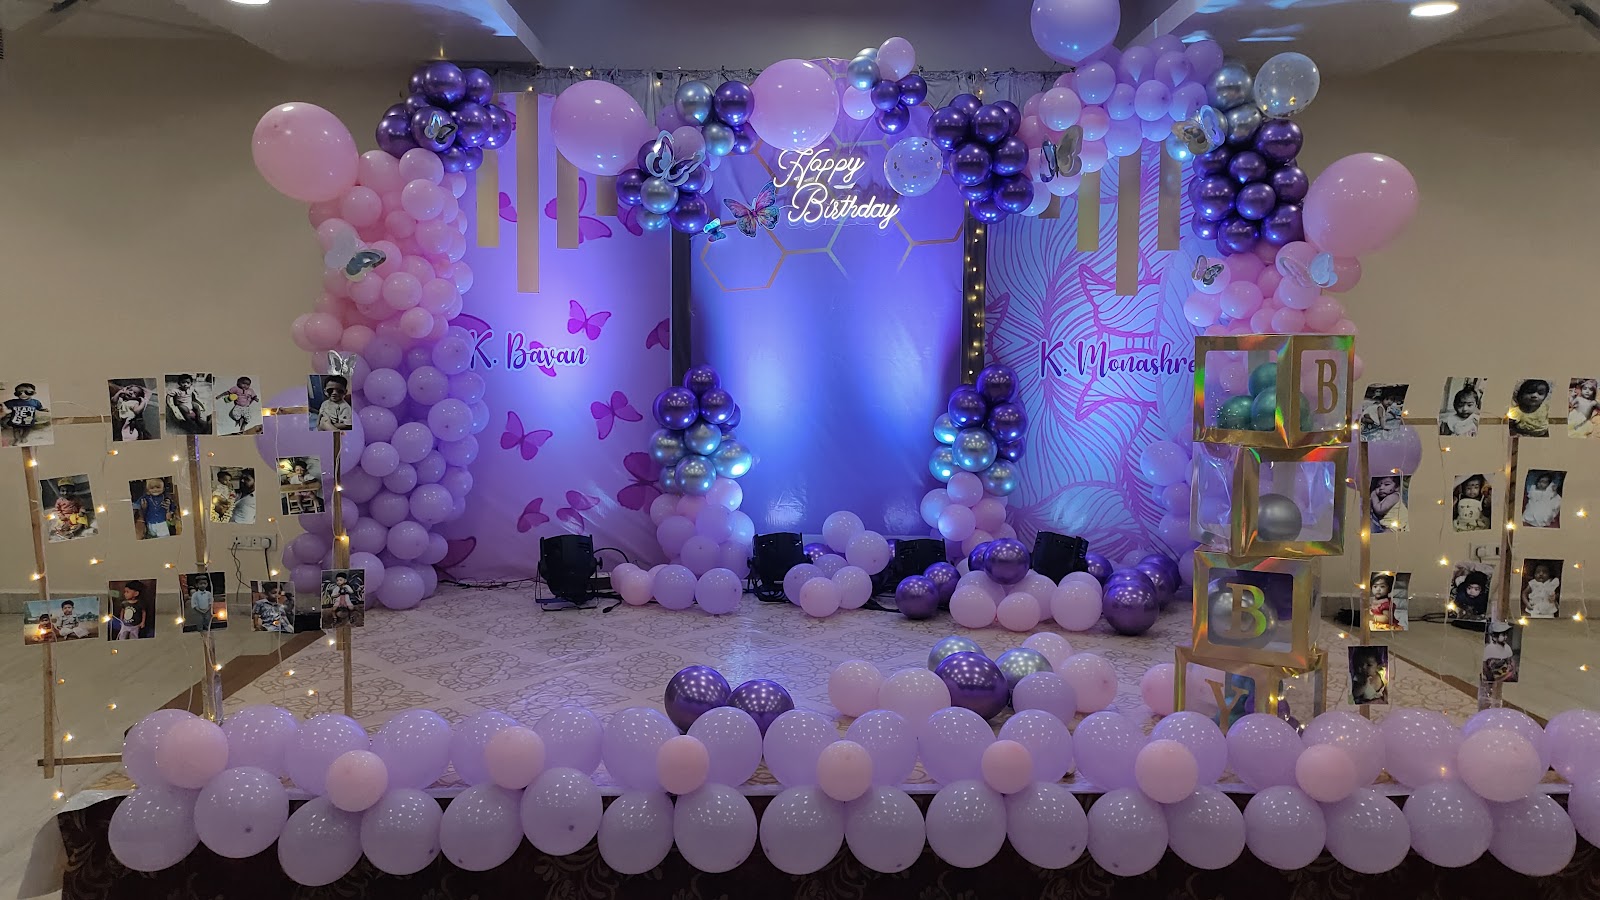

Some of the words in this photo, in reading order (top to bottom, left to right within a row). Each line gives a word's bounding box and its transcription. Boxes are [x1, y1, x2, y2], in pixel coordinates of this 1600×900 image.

[773, 148, 865, 188] Happy
[787, 182, 900, 229] Birthday
[470, 331, 497, 369] K.
[507, 332, 588, 369] Bavan
[1041, 341, 1067, 377] K.
[1314, 359, 1338, 414] B
[1226, 583, 1267, 639] B
[1204, 679, 1249, 737] Y
